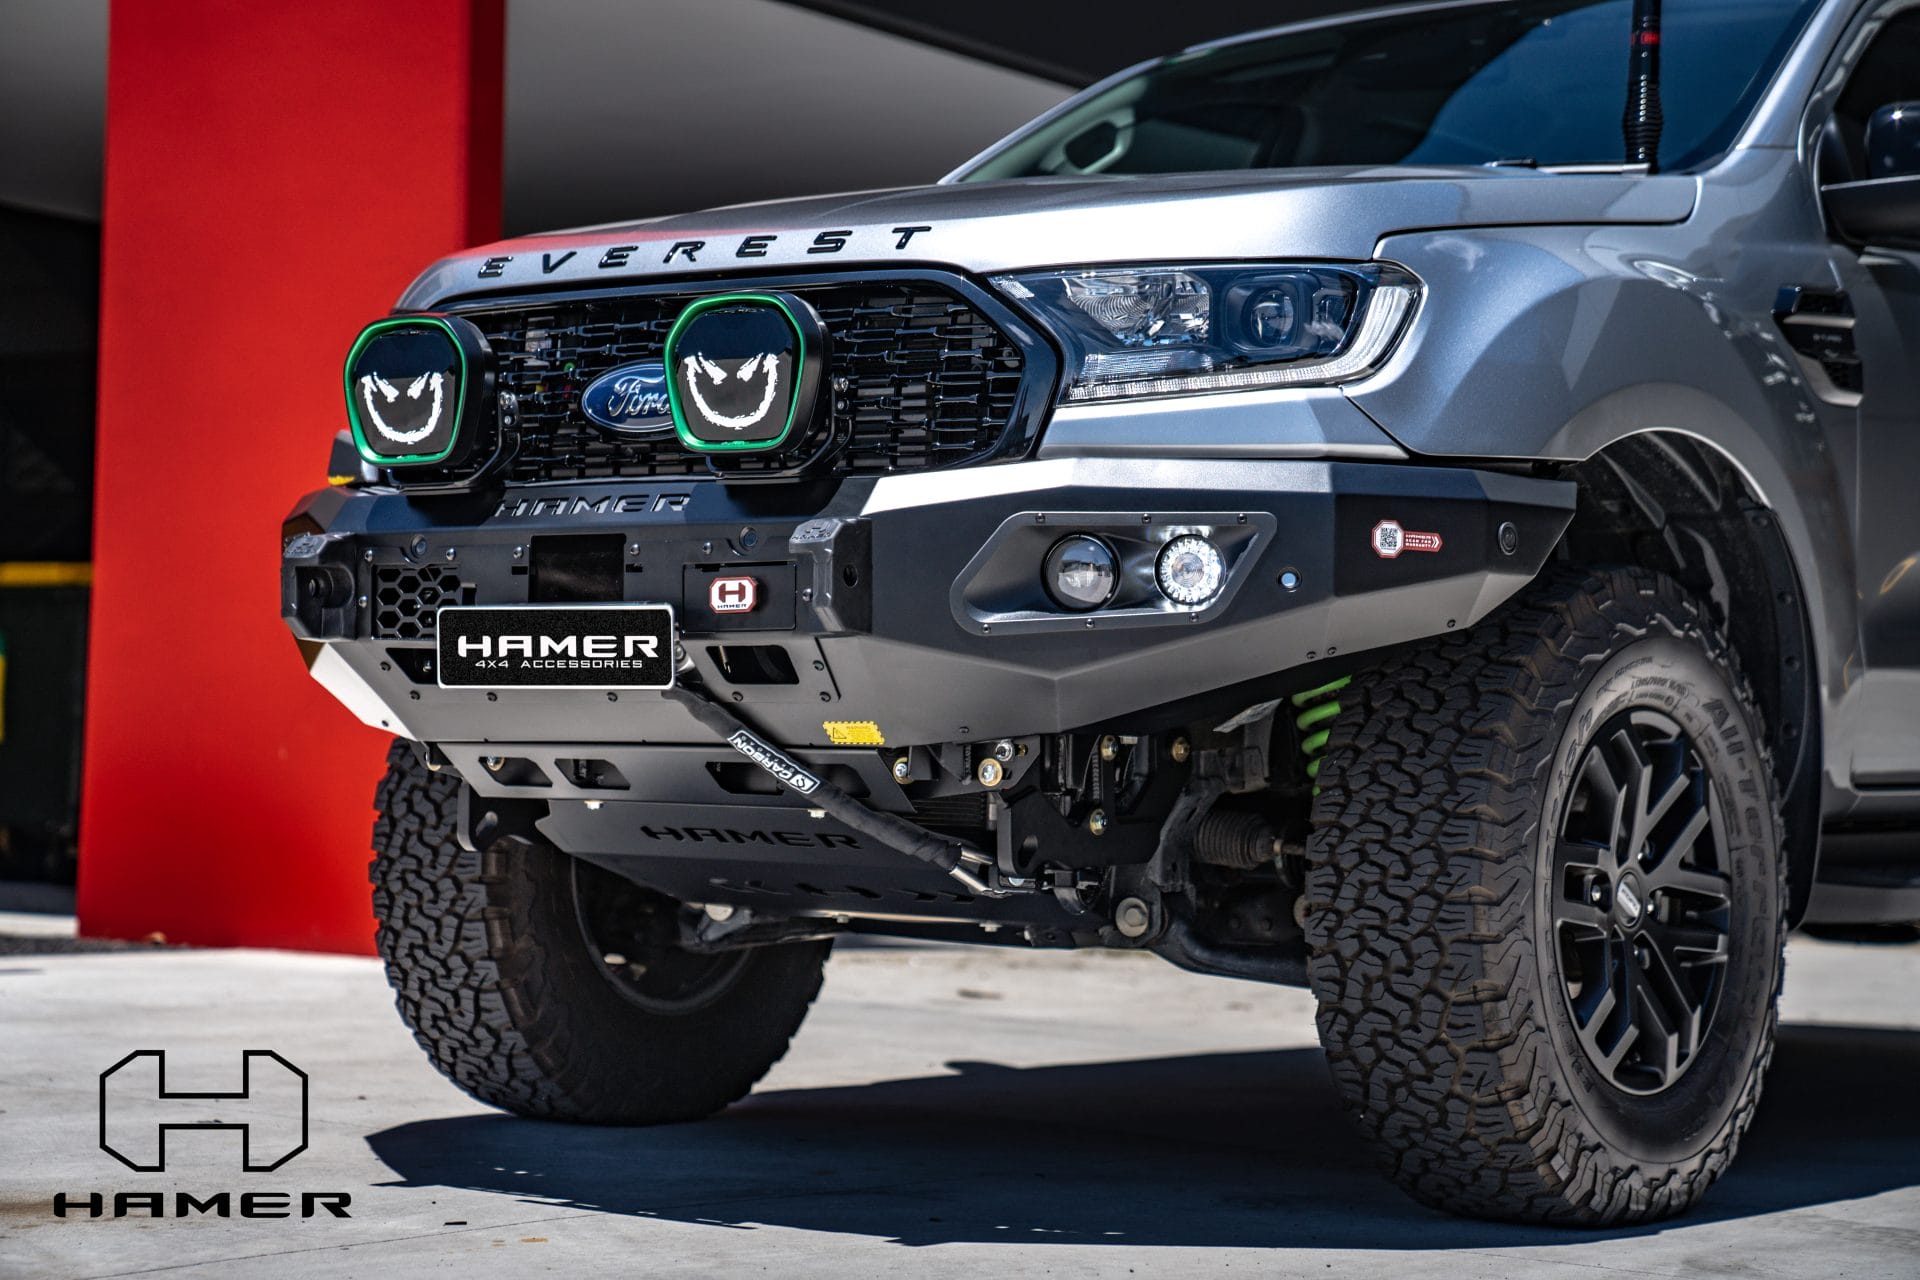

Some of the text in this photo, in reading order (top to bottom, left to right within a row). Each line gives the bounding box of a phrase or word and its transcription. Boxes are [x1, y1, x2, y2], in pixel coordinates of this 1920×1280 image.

[477, 226, 932, 278] EVEREST
[495, 493, 691, 517] HAMER
[457, 635, 659, 658] HAMER
[475, 659, 643, 669] 4X4 ACCESSORIES
[733, 736, 790, 781] CARBON
[639, 825, 865, 849] HAMER
